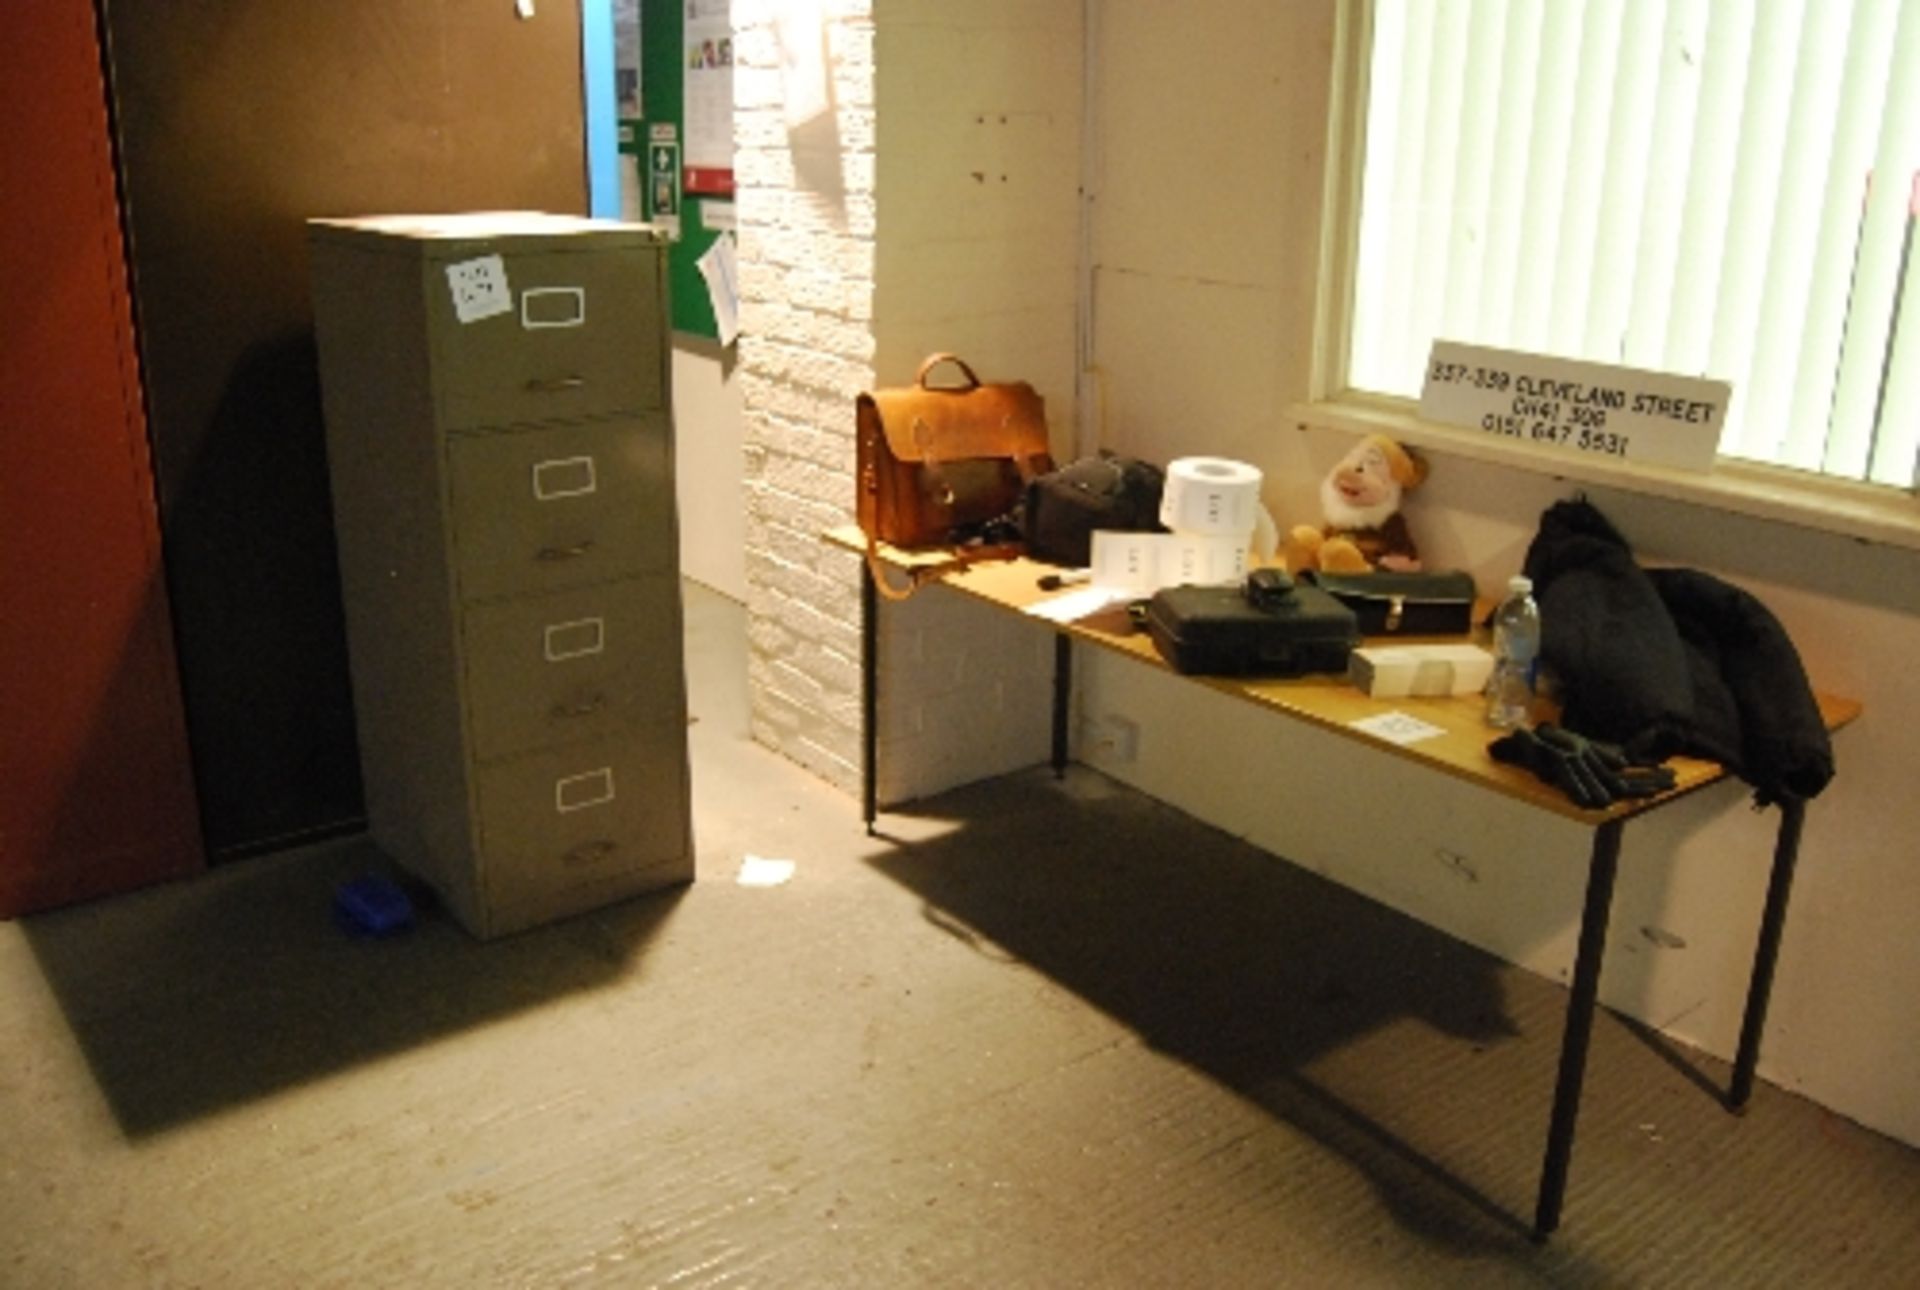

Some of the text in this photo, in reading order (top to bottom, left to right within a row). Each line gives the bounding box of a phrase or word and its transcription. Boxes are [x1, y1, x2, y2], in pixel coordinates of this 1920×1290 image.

[1516, 376, 1625, 409] CLEVELAND
[1632, 394, 1716, 423] STREET
[1531, 421, 1571, 444] 647
